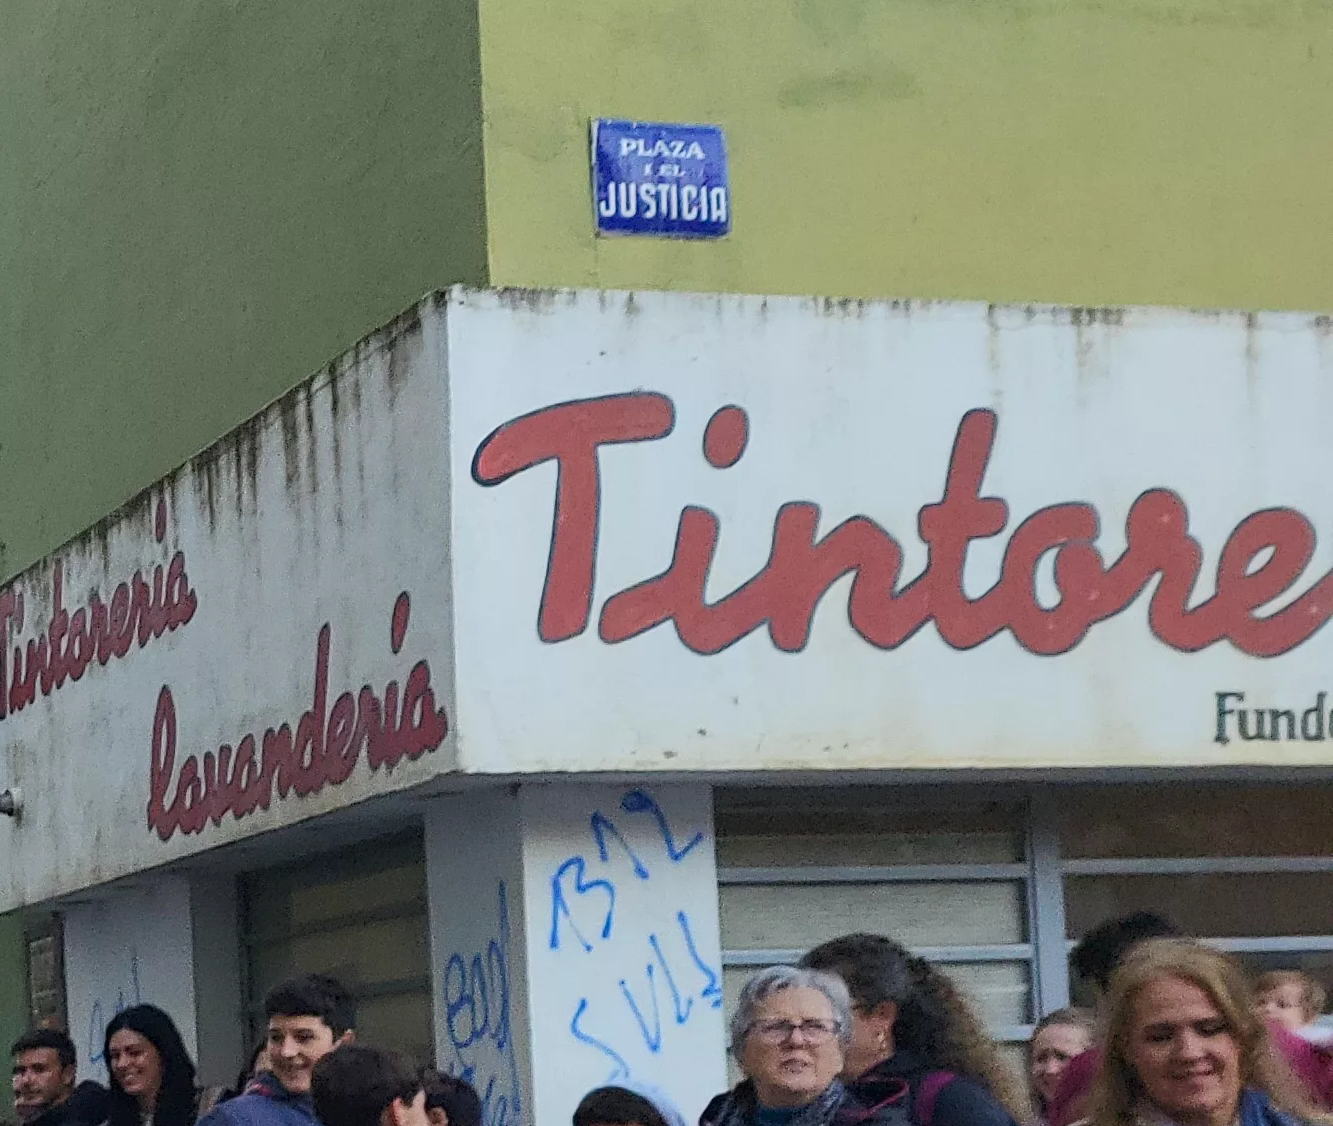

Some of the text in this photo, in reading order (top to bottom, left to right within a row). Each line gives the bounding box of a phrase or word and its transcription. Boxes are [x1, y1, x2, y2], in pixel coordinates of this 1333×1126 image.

[619, 137, 706, 160] PLAZA
[600, 181, 728, 223] JUSTICIA
[471, 390, 1333, 658] Tintore
[1213, 691, 1333, 746] Fund
